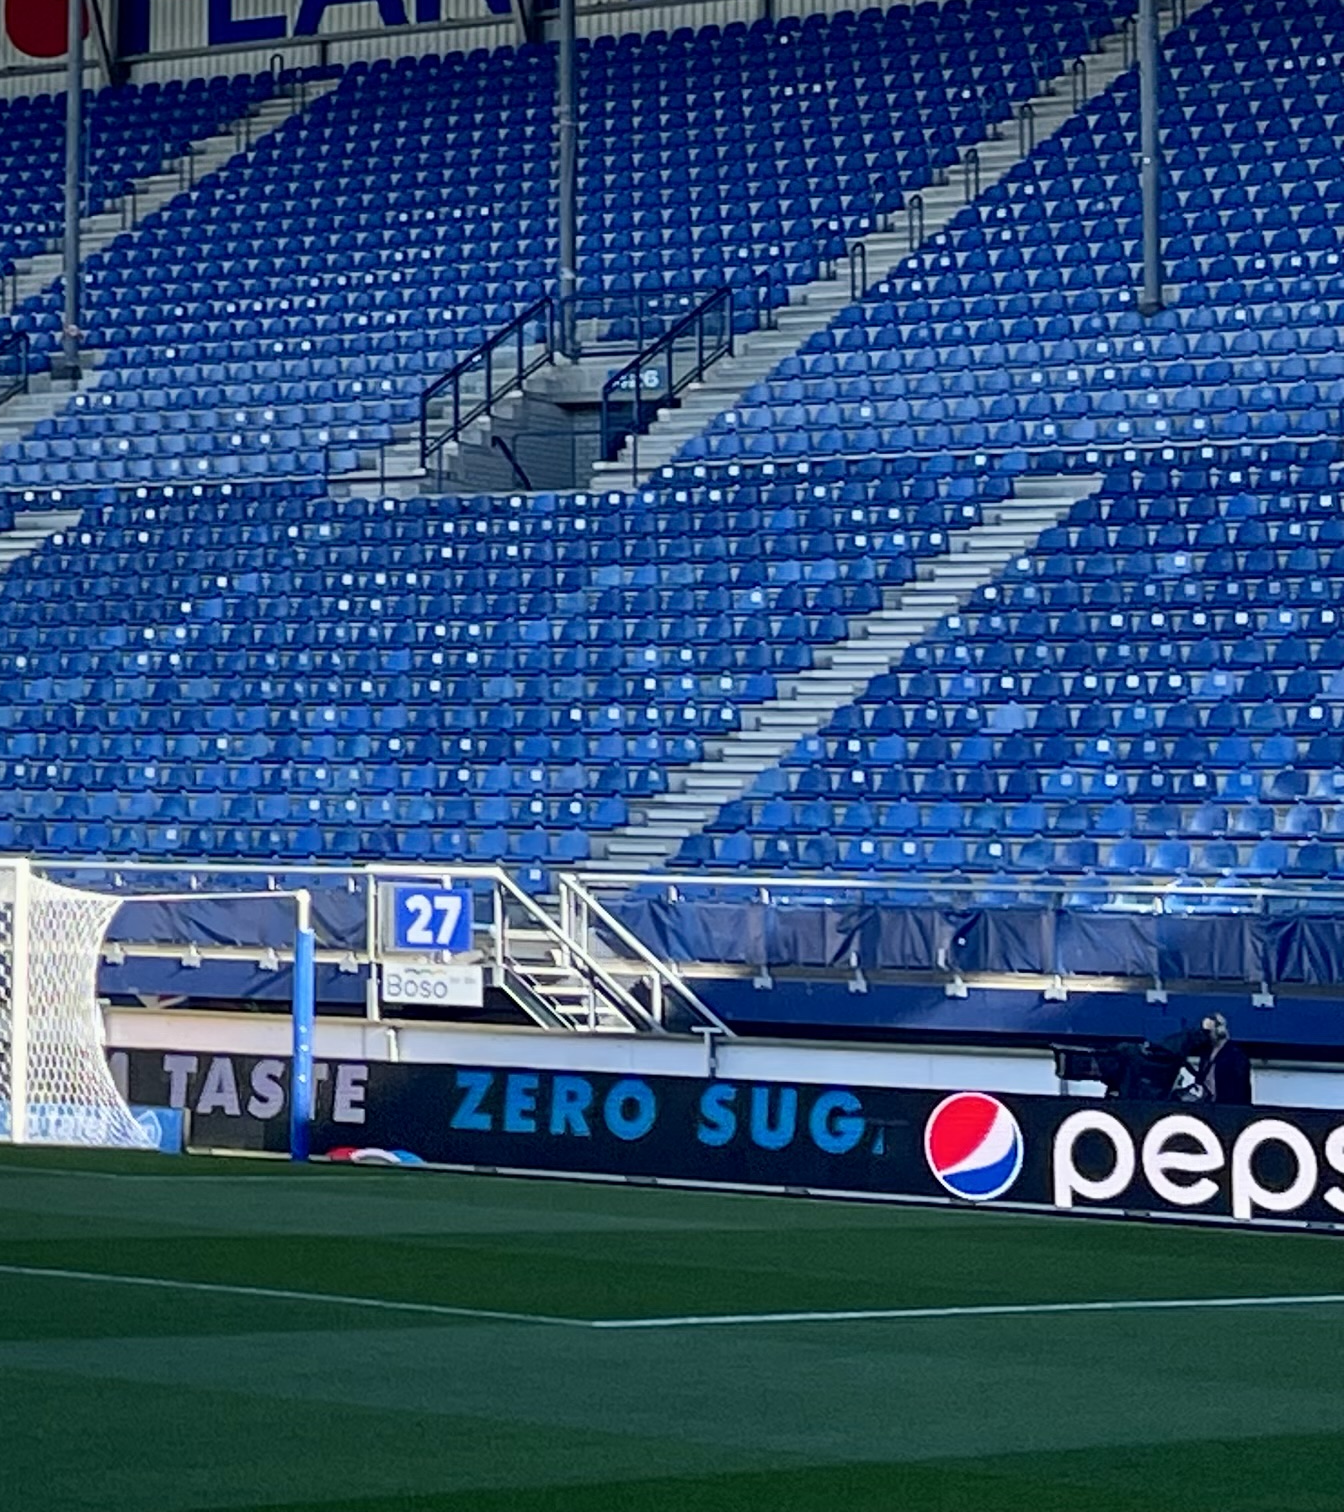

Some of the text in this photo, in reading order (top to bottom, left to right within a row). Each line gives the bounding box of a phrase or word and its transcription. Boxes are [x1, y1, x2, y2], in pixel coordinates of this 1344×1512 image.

[405, 894, 462, 945] 27
[449, 1070, 885, 1155] ZERO SUG
